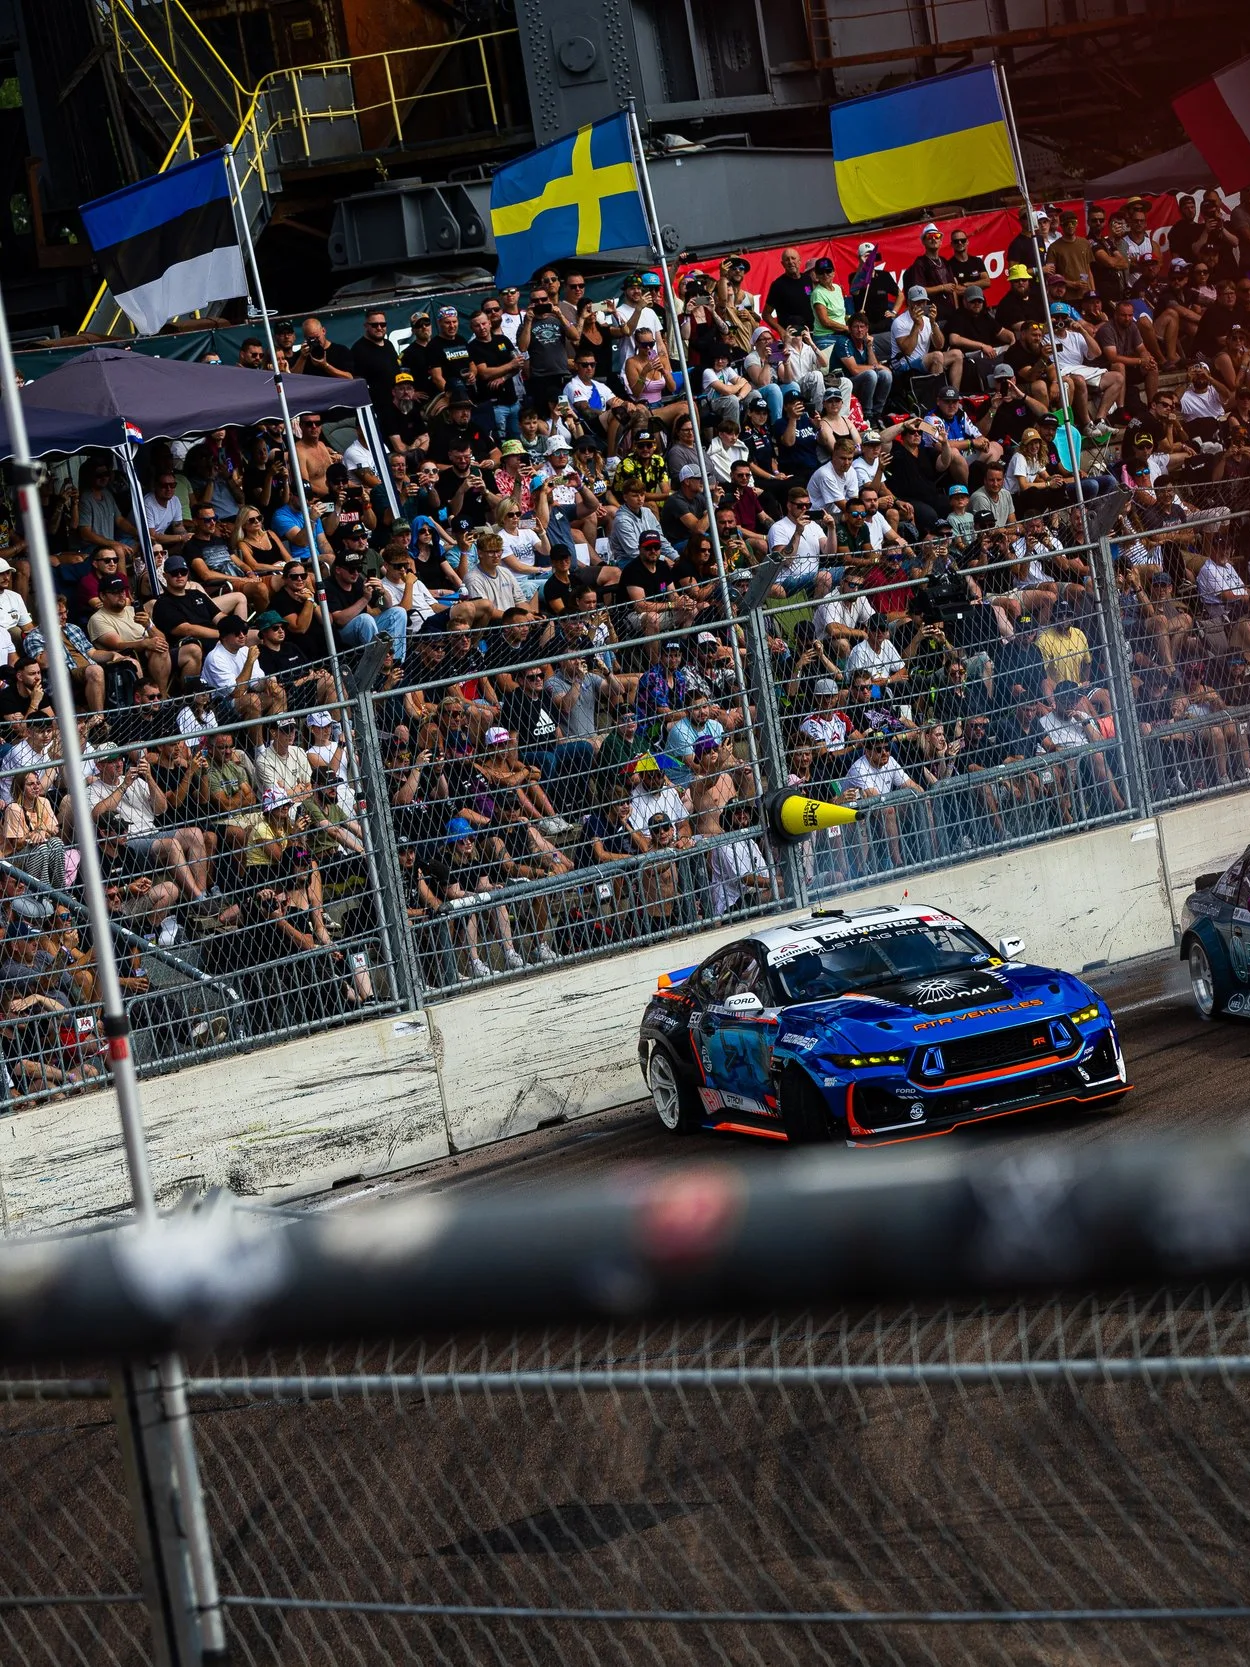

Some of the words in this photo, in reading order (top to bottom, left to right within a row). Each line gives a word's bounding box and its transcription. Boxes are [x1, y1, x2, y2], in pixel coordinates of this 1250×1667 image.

[809, 931, 892, 956] MUSTANG
[895, 926, 930, 938] RTR
[728, 997, 756, 1007] FORD
[913, 1017, 952, 1032] RTR
[955, 999, 1044, 1022] VEHICLES
